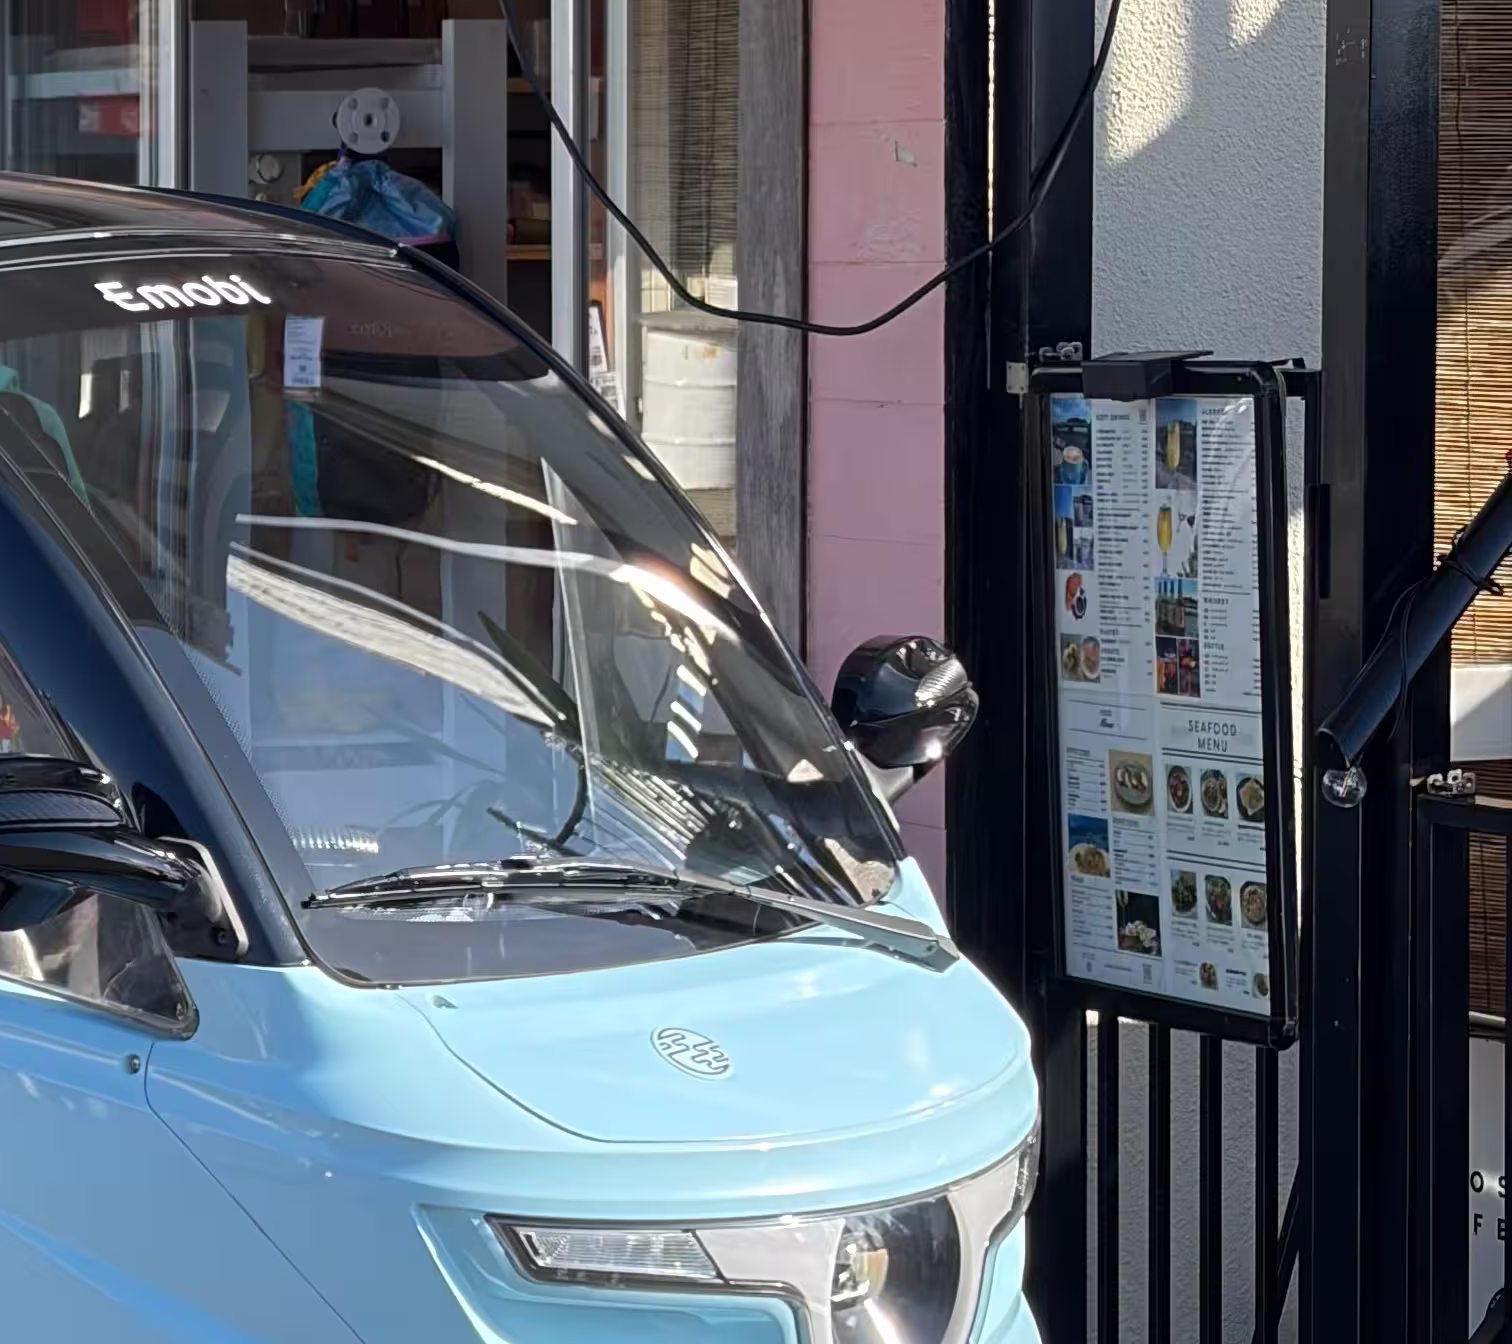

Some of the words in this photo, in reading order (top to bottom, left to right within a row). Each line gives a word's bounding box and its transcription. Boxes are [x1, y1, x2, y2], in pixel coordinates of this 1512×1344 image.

[94, 274, 272, 312] Emobi
[1188, 719, 1237, 737] SEAFOOD
[1197, 737, 1228, 753] MENU
